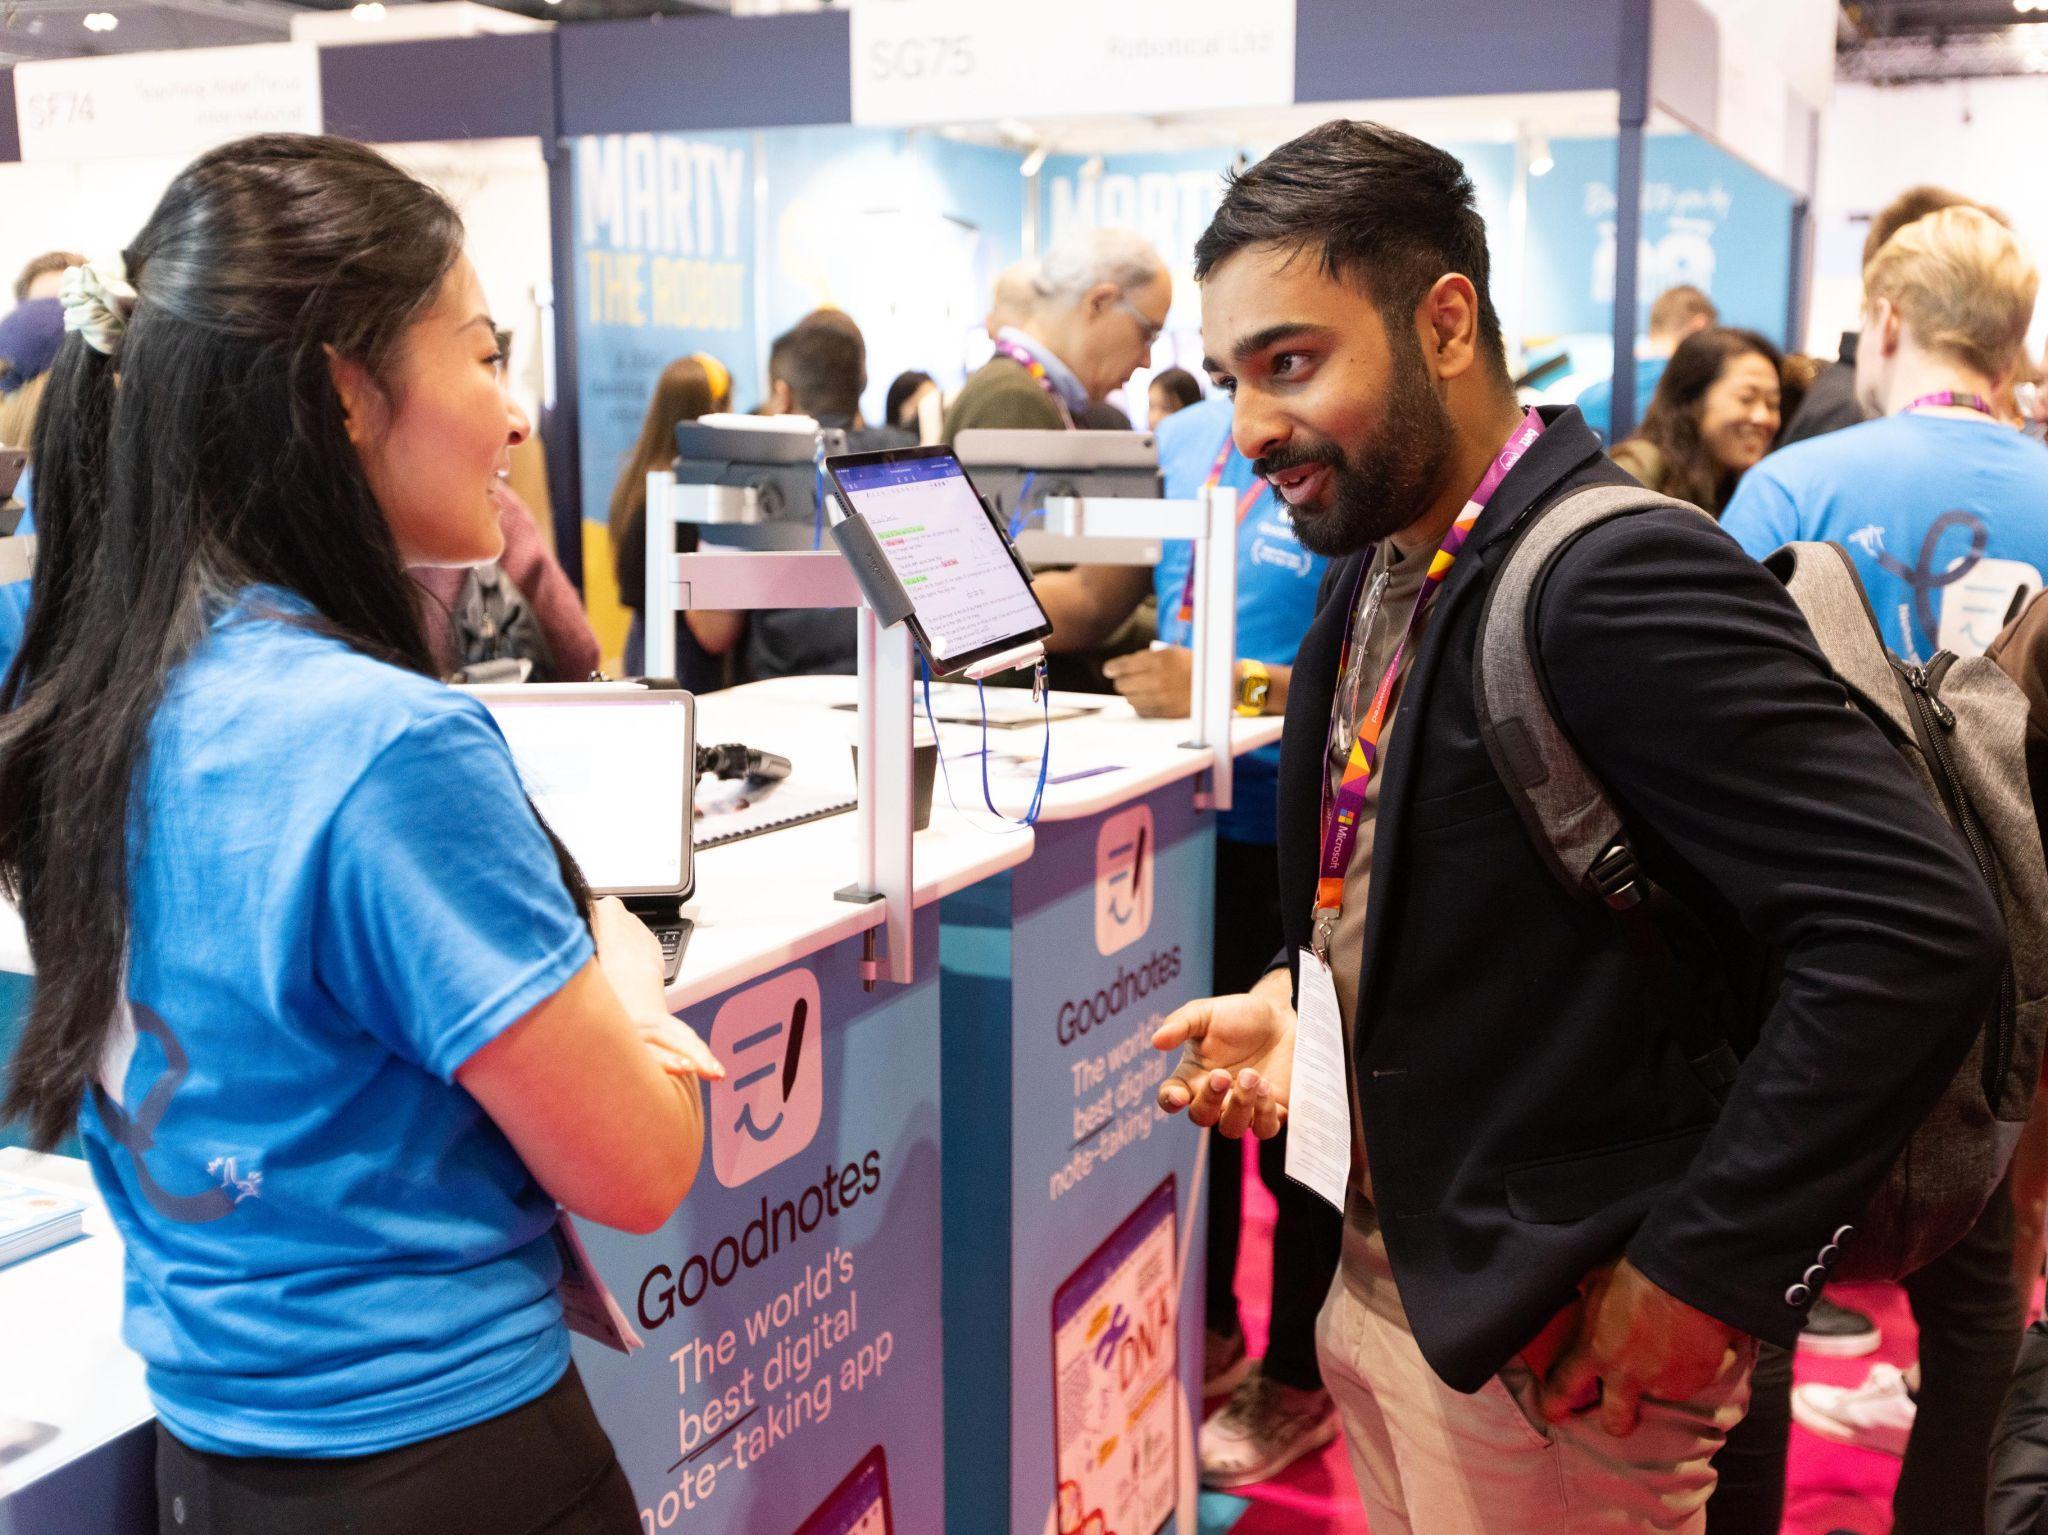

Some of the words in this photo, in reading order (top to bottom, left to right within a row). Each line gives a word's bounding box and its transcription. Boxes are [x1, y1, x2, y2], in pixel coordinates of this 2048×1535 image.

[869, 34, 978, 81] SG75
[578, 133, 746, 258] MARTY
[586, 250, 646, 328] THE
[1329, 825, 1349, 870] Microsoft
[1056, 944, 1182, 1048] Goodnotes
[1071, 1055, 1106, 1098] The
[1072, 1086, 1114, 1141] best
[1115, 1050, 1167, 1109] digital
[1049, 1103, 1153, 1201] note-taking
[637, 1149, 881, 1331] Goodnotes
[669, 1328, 737, 1395] The
[744, 1247, 854, 1348] world's
[839, 1330, 894, 1393] app
[678, 1367, 757, 1455] best
[762, 1290, 858, 1391] digital
